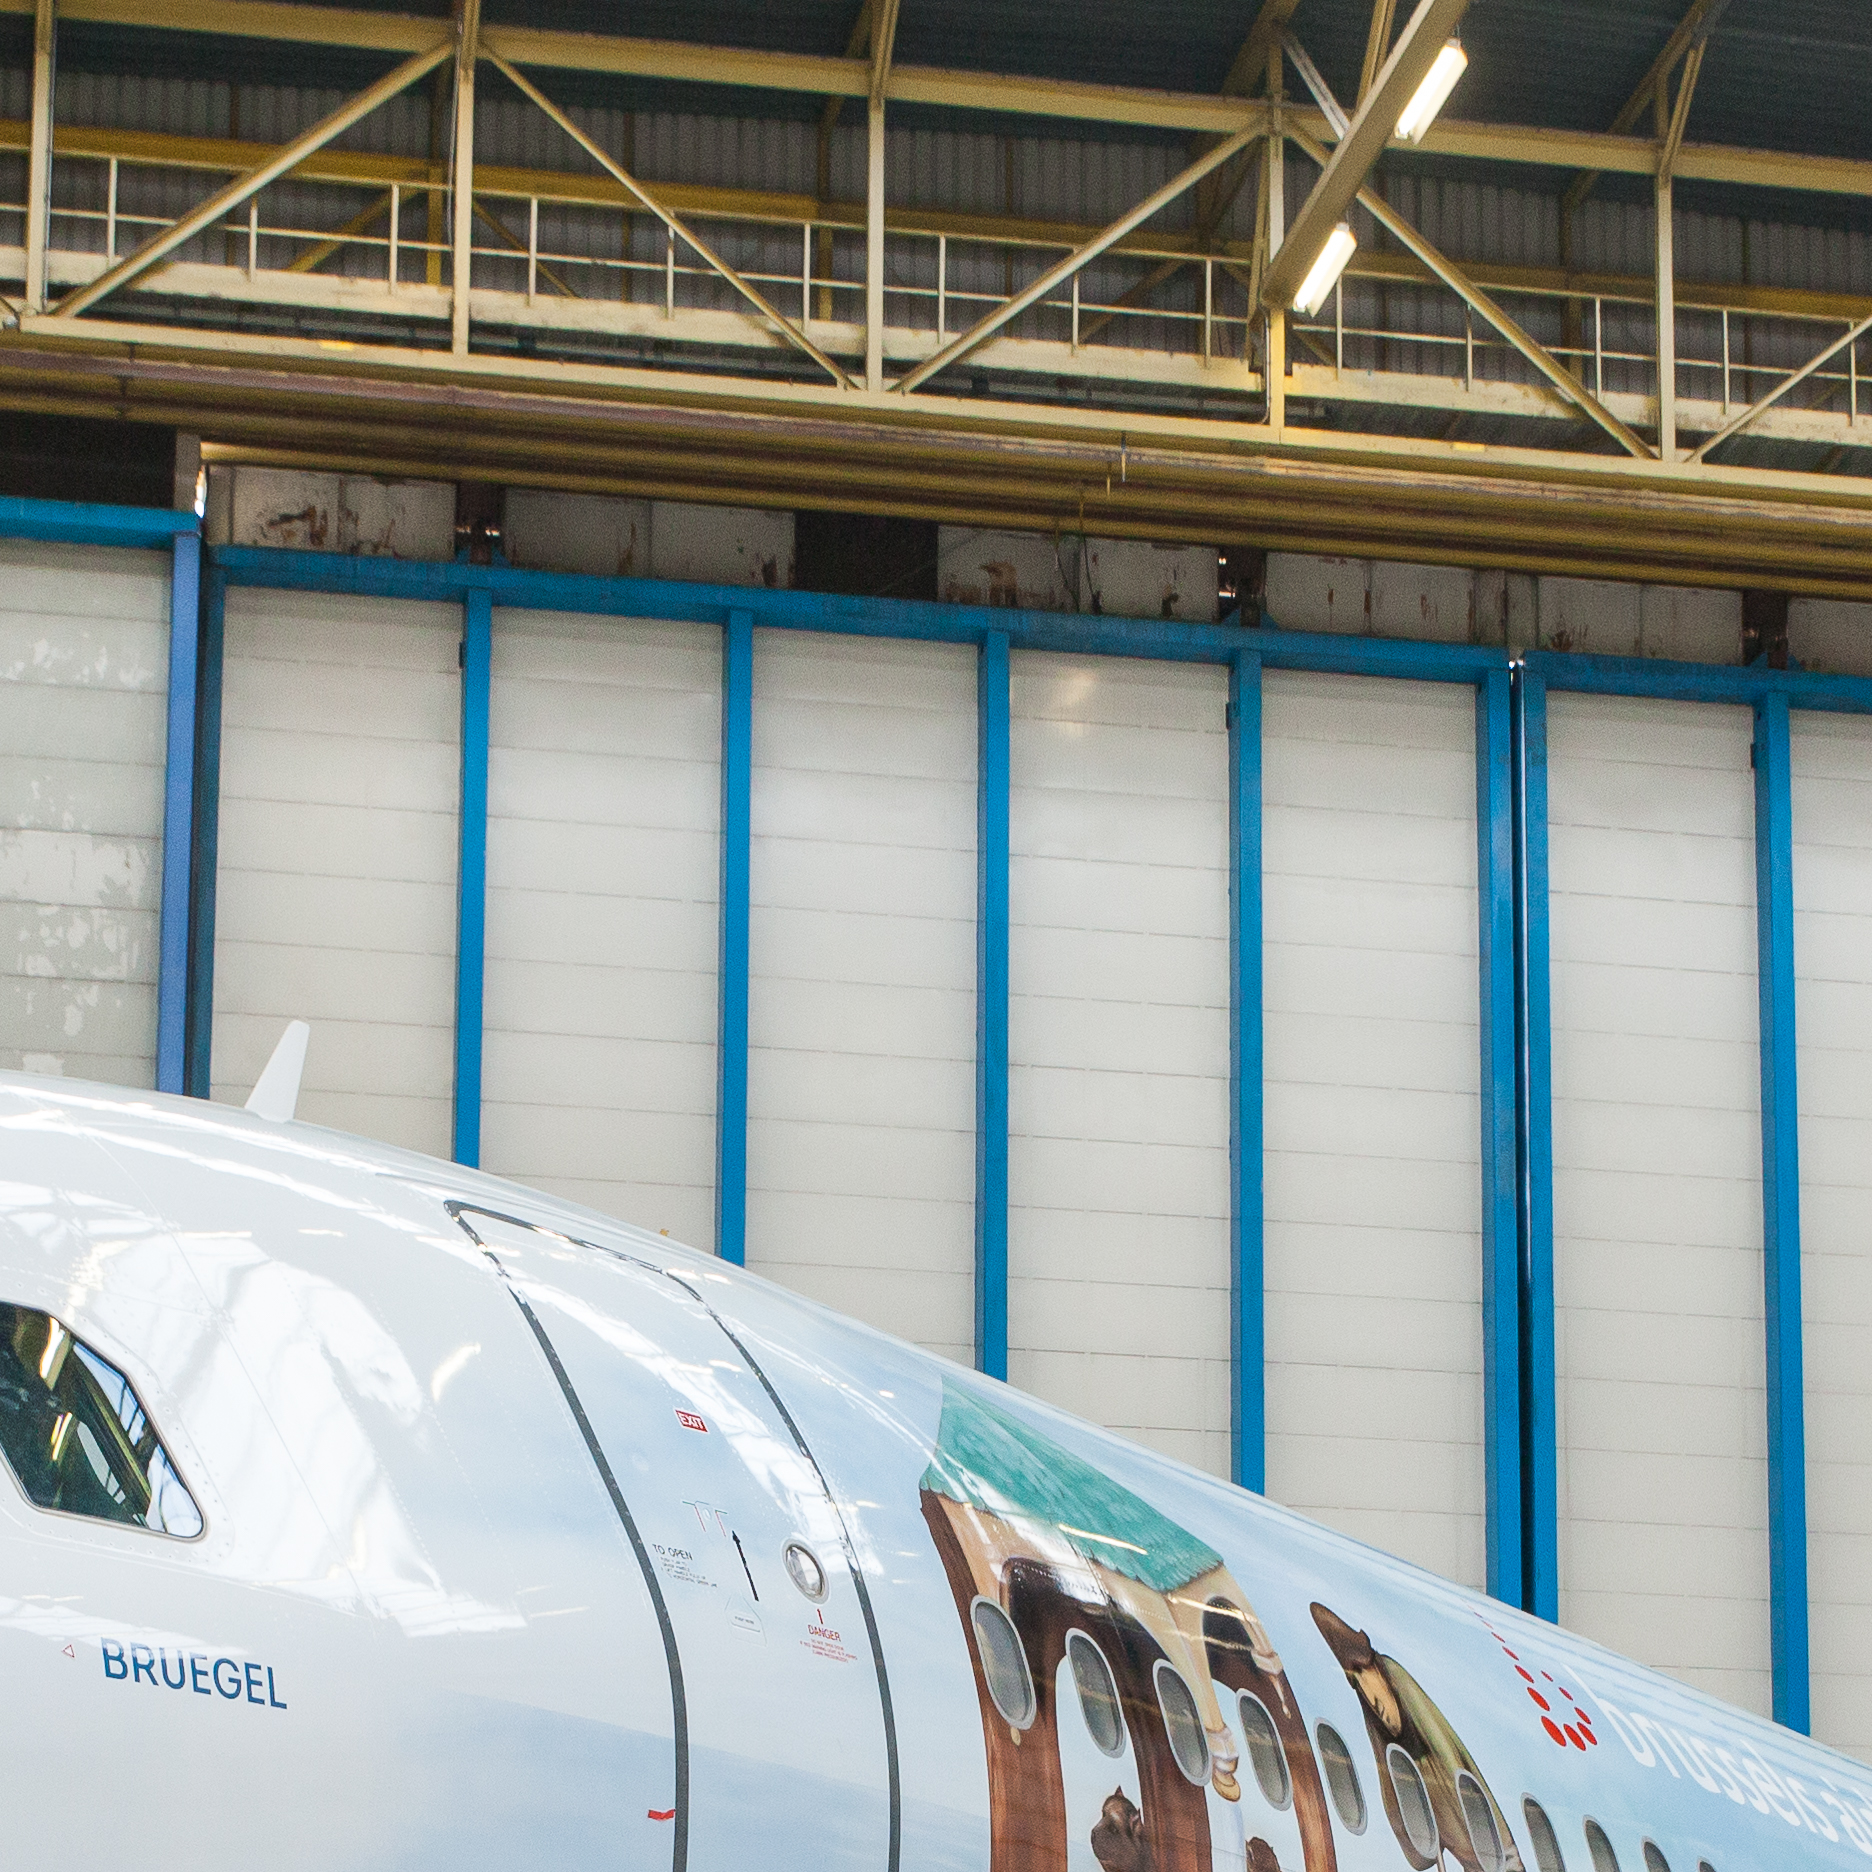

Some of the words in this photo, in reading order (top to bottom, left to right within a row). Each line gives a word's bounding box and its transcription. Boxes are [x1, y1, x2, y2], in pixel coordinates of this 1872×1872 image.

[677, 1412, 705, 1430] EXIT
[652, 1543, 665, 1555] TO
[668, 1547, 693, 1561] OPEN
[807, 1624, 841, 1642] DANGER
[100, 1637, 288, 1710] BRUEGEL
[1563, 1662, 1840, 1842] brussels
